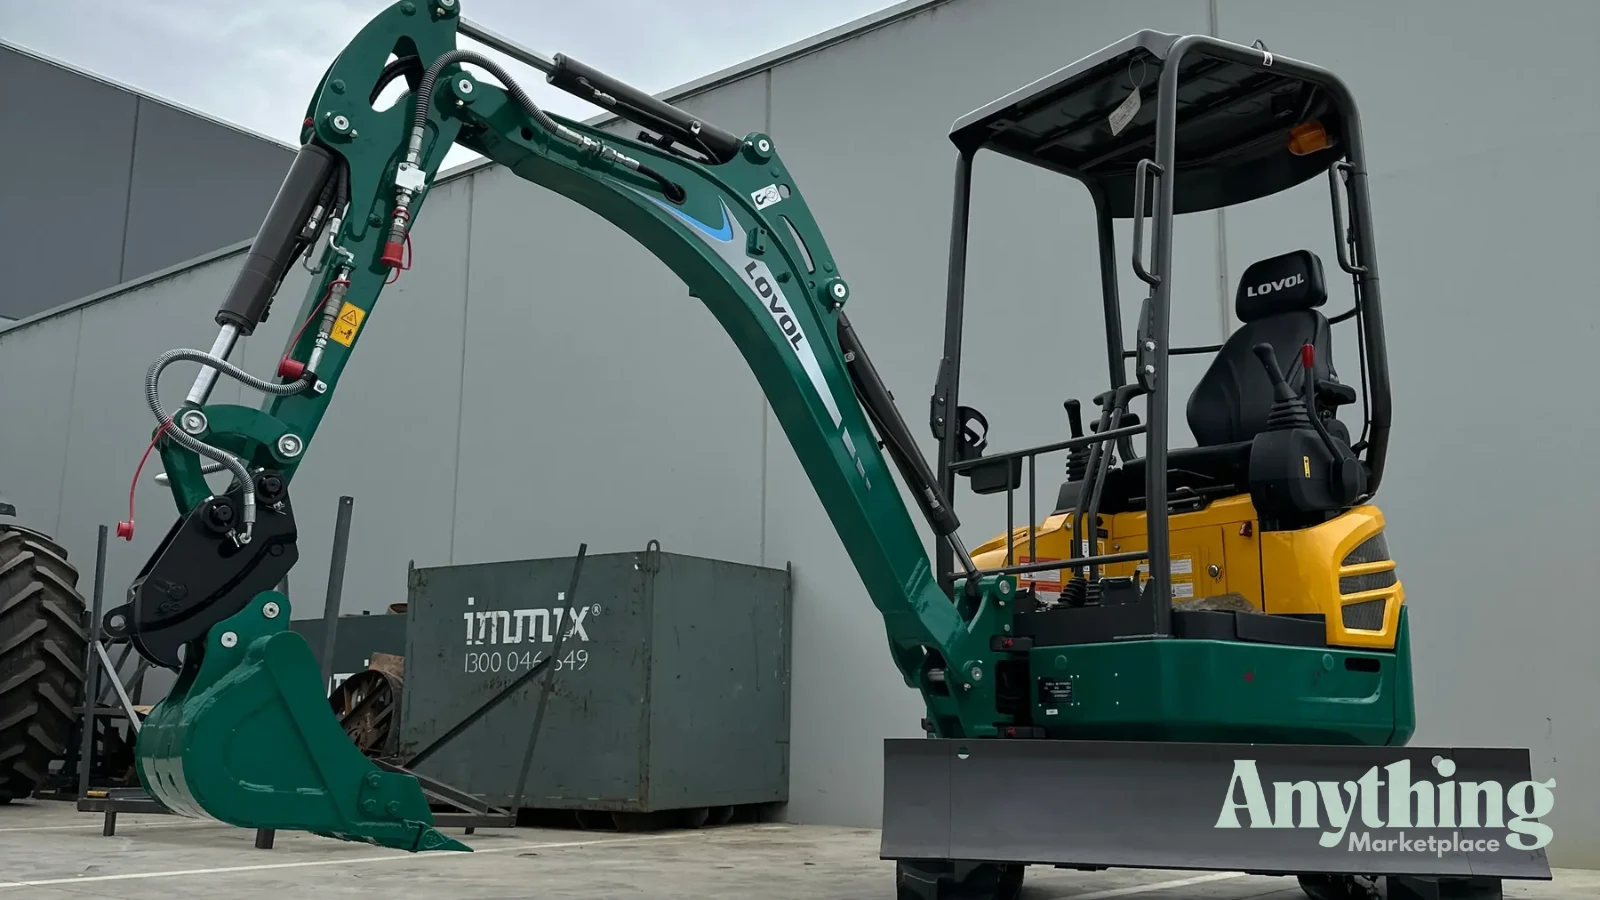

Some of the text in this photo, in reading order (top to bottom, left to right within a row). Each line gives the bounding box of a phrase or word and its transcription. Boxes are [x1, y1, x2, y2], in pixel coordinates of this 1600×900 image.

[1247, 273, 1304, 297] LOVOL
[744, 261, 803, 351] LOVOL
[464, 652, 502, 672] 1300
